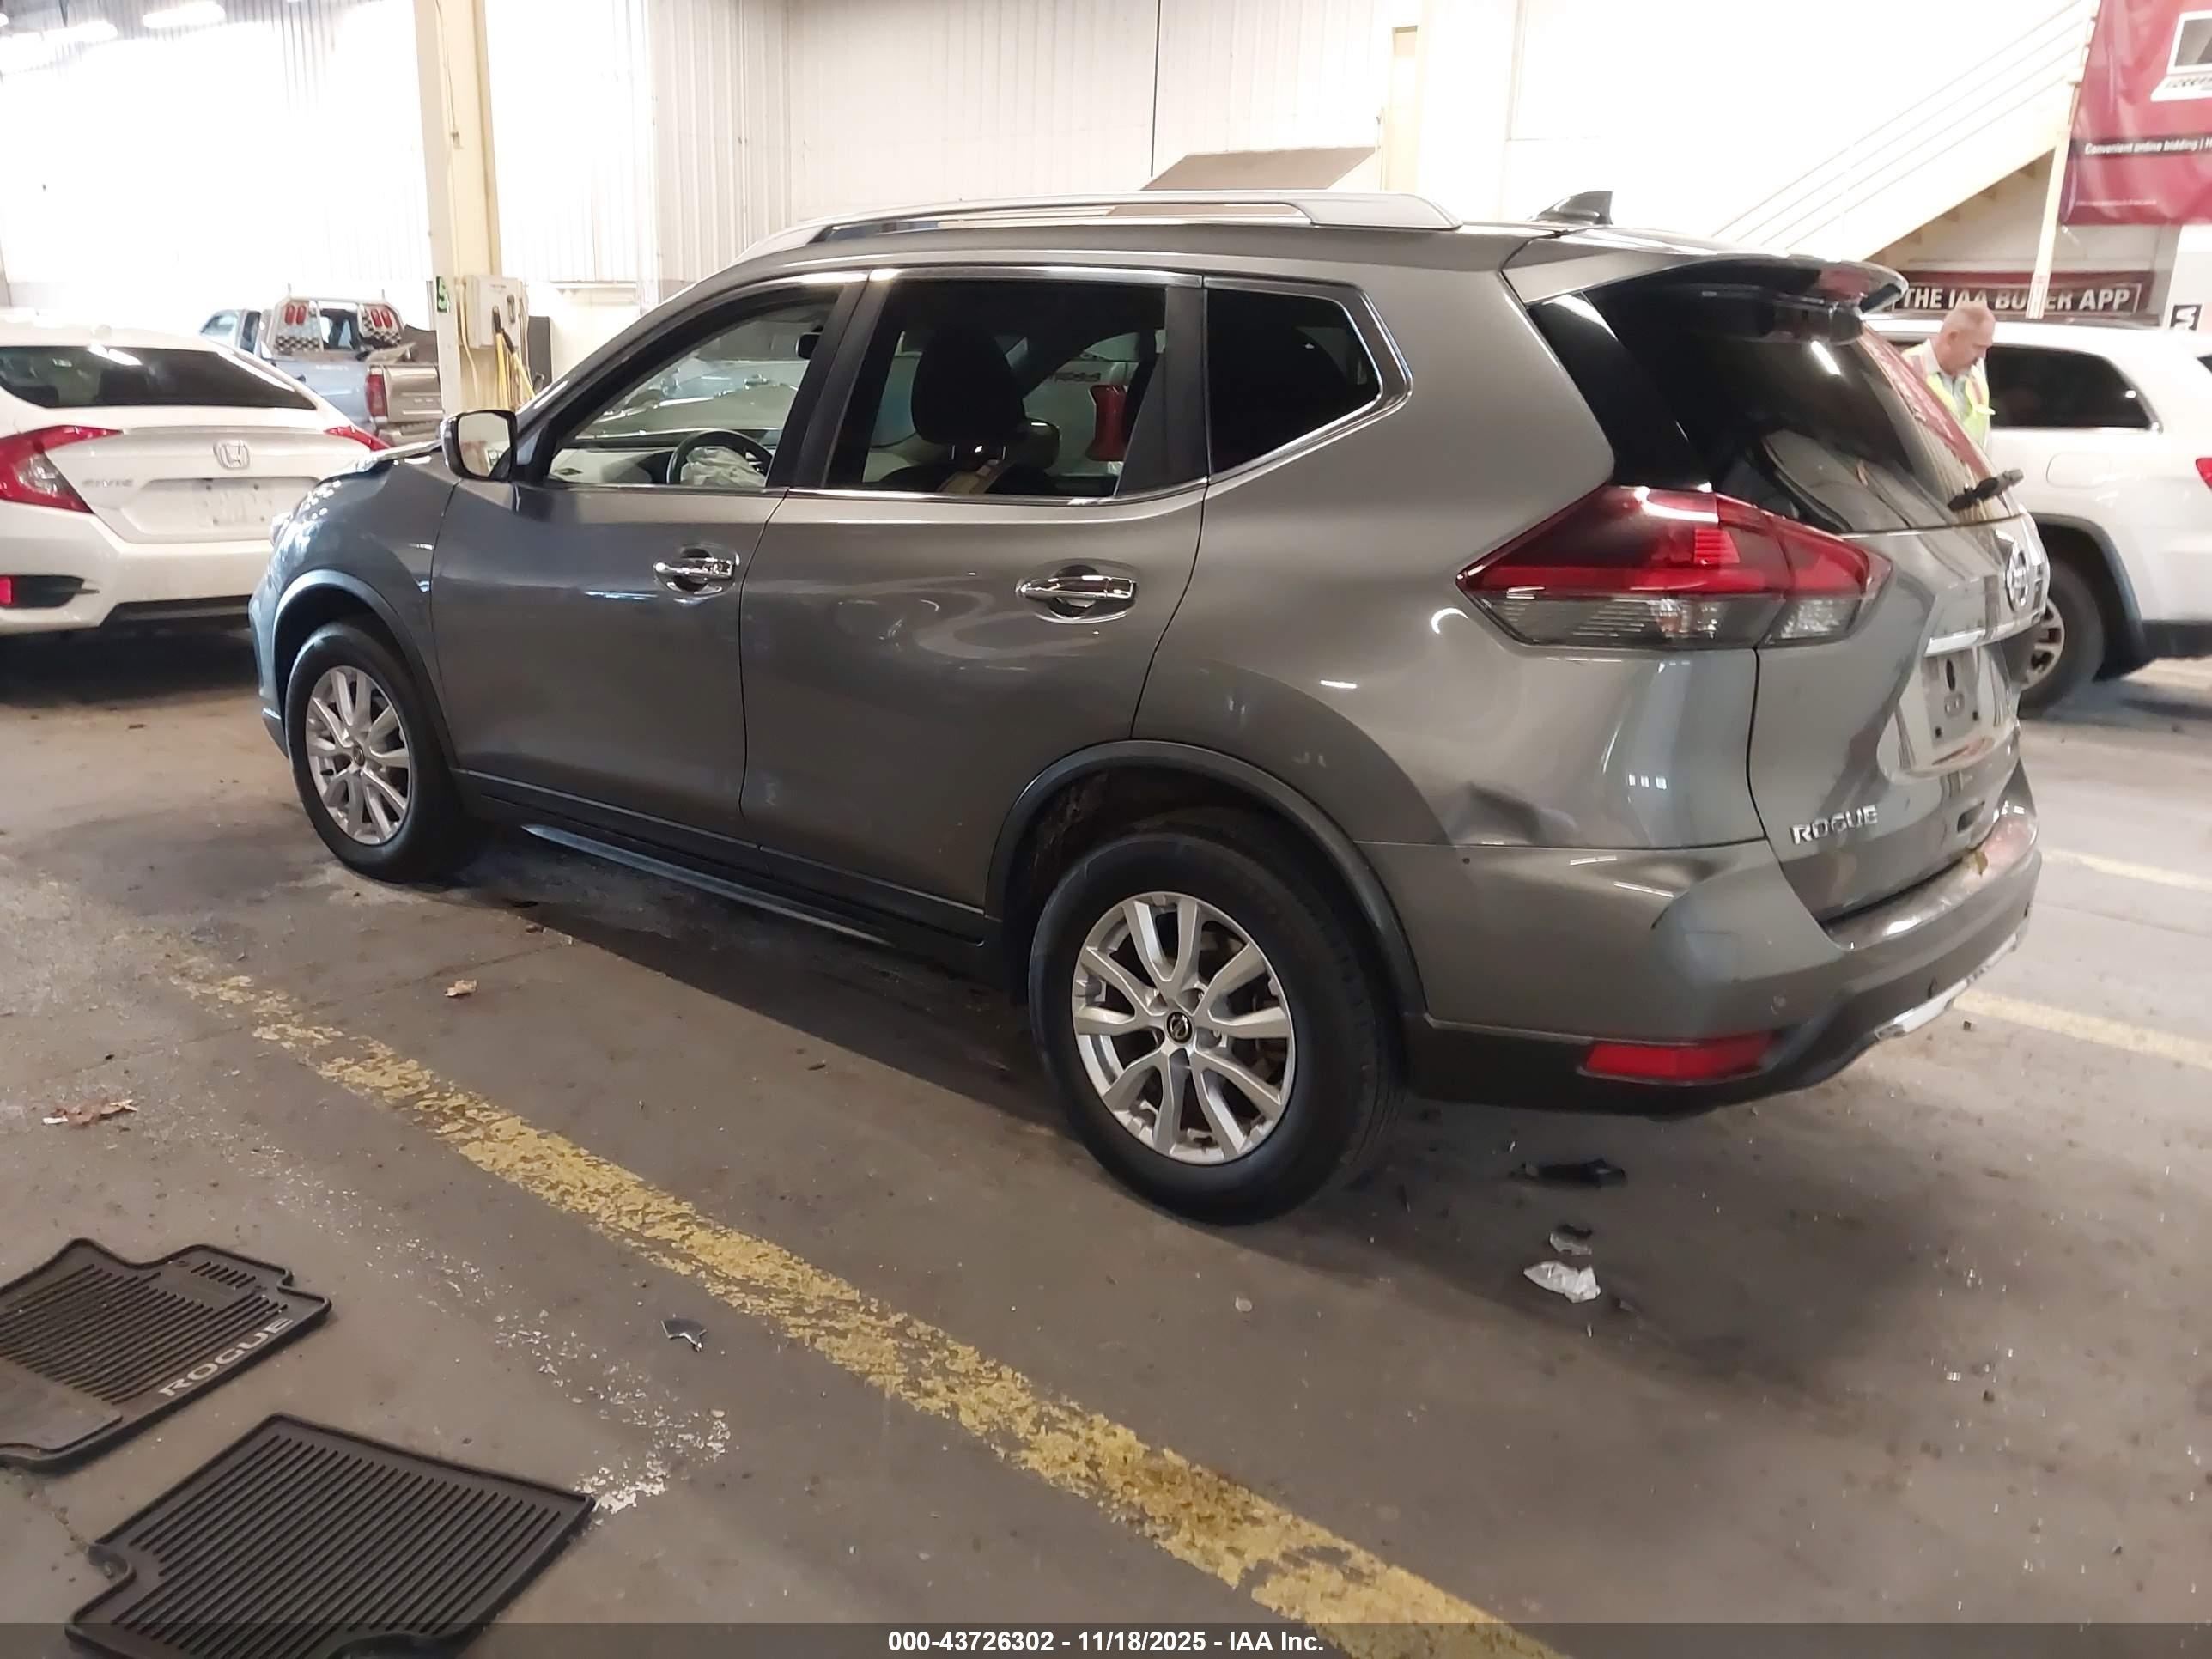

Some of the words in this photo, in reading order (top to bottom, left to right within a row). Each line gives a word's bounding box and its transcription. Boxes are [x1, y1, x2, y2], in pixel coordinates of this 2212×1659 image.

[2085, 142, 2134, 155] Convenient
[2163, 138, 2199, 151] bidding
[1903, 288, 1943, 309] THE
[1948, 288, 1989, 307] IAA
[1995, 289, 2073, 310] BUER
[2079, 289, 2130, 310] APP
[1790, 805, 1877, 845] ROGUE
[158, 1317, 293, 1396] ROGUE
